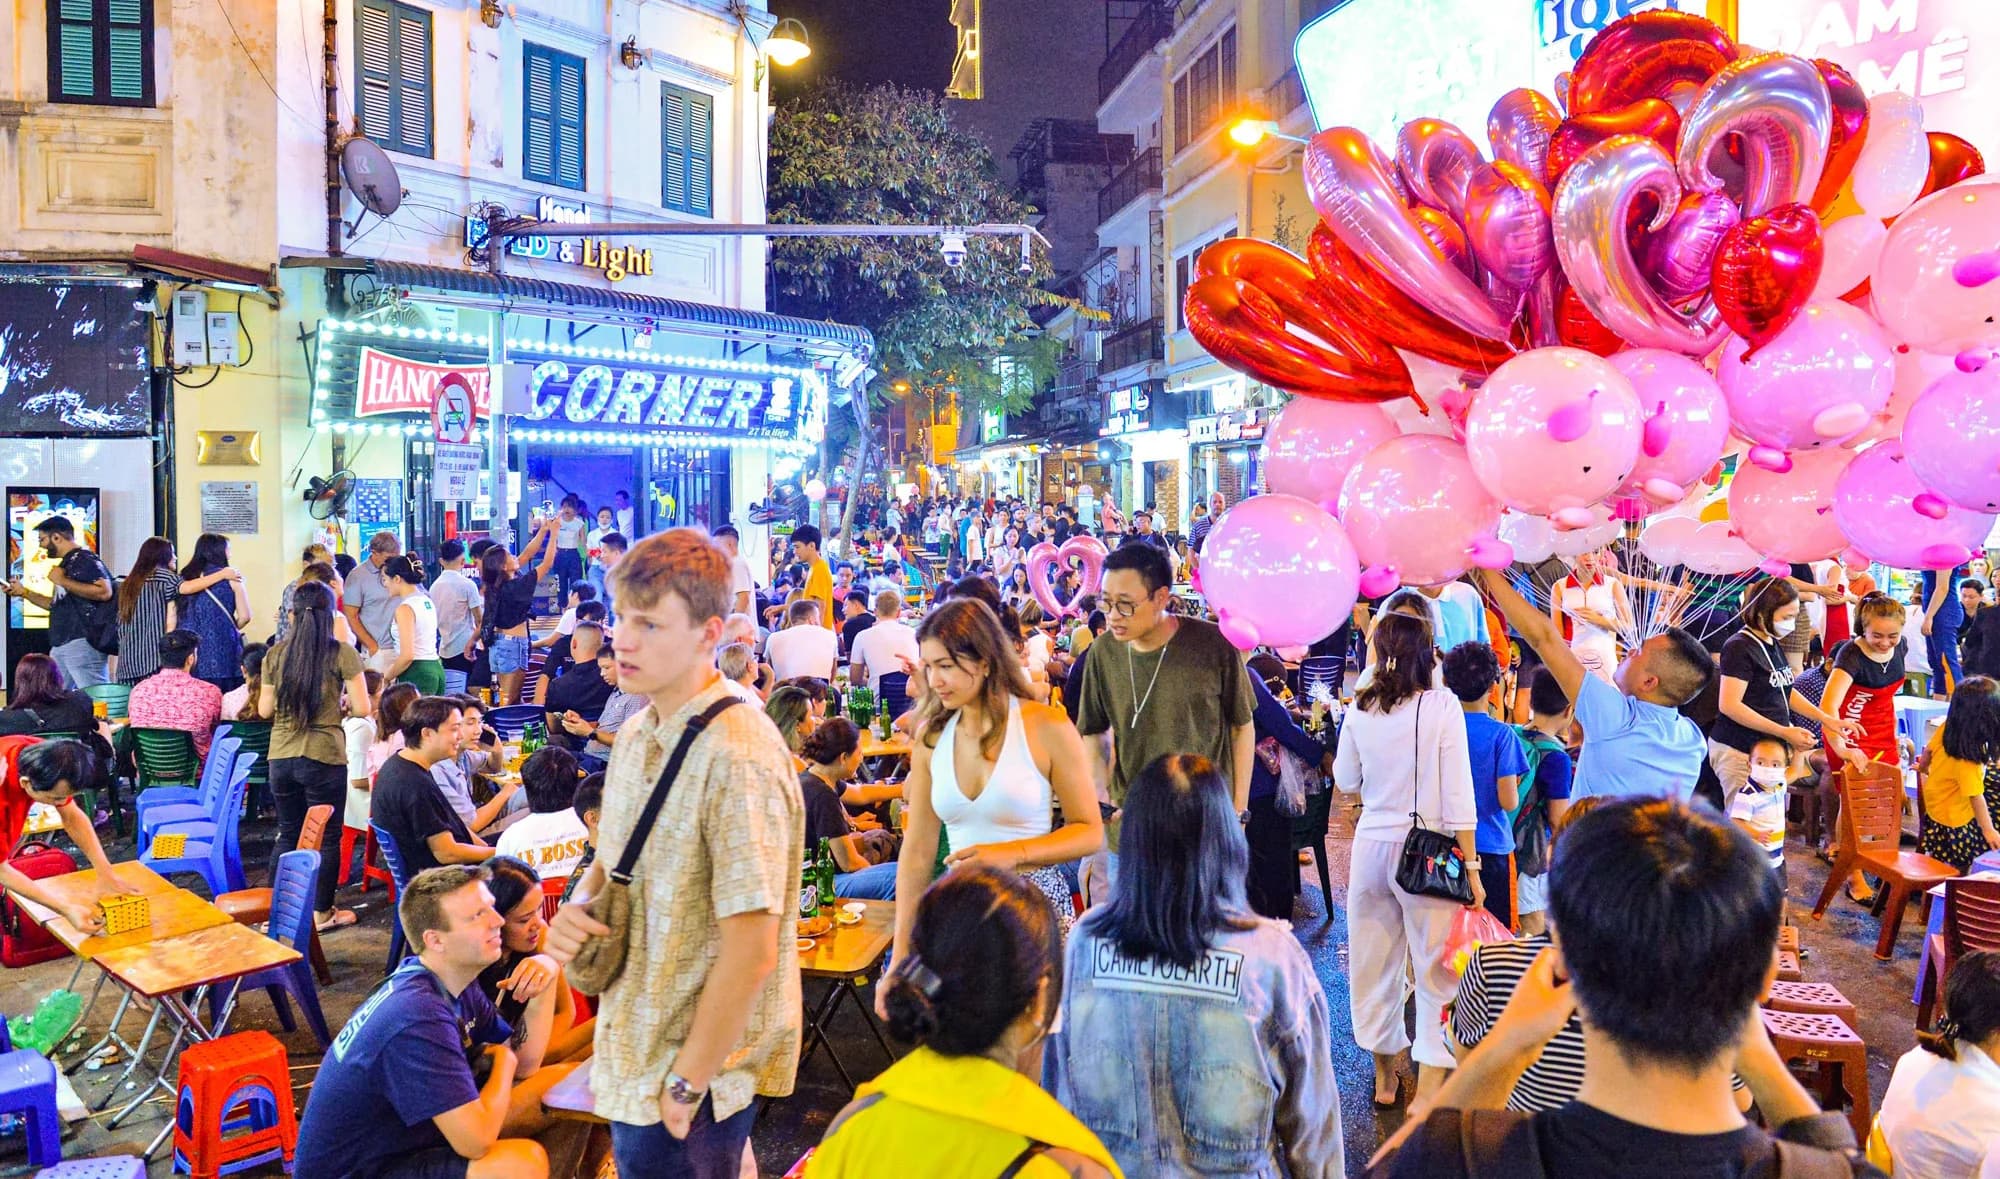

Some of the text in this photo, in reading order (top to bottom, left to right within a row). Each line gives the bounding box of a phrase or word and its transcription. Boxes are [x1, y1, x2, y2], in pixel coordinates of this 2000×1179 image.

[1534, 0, 1678, 60] Tig
[1858, 28, 1969, 97] MÊ
[559, 240, 575, 263] &
[581, 237, 654, 281] Light
[527, 360, 763, 429] CORNER
